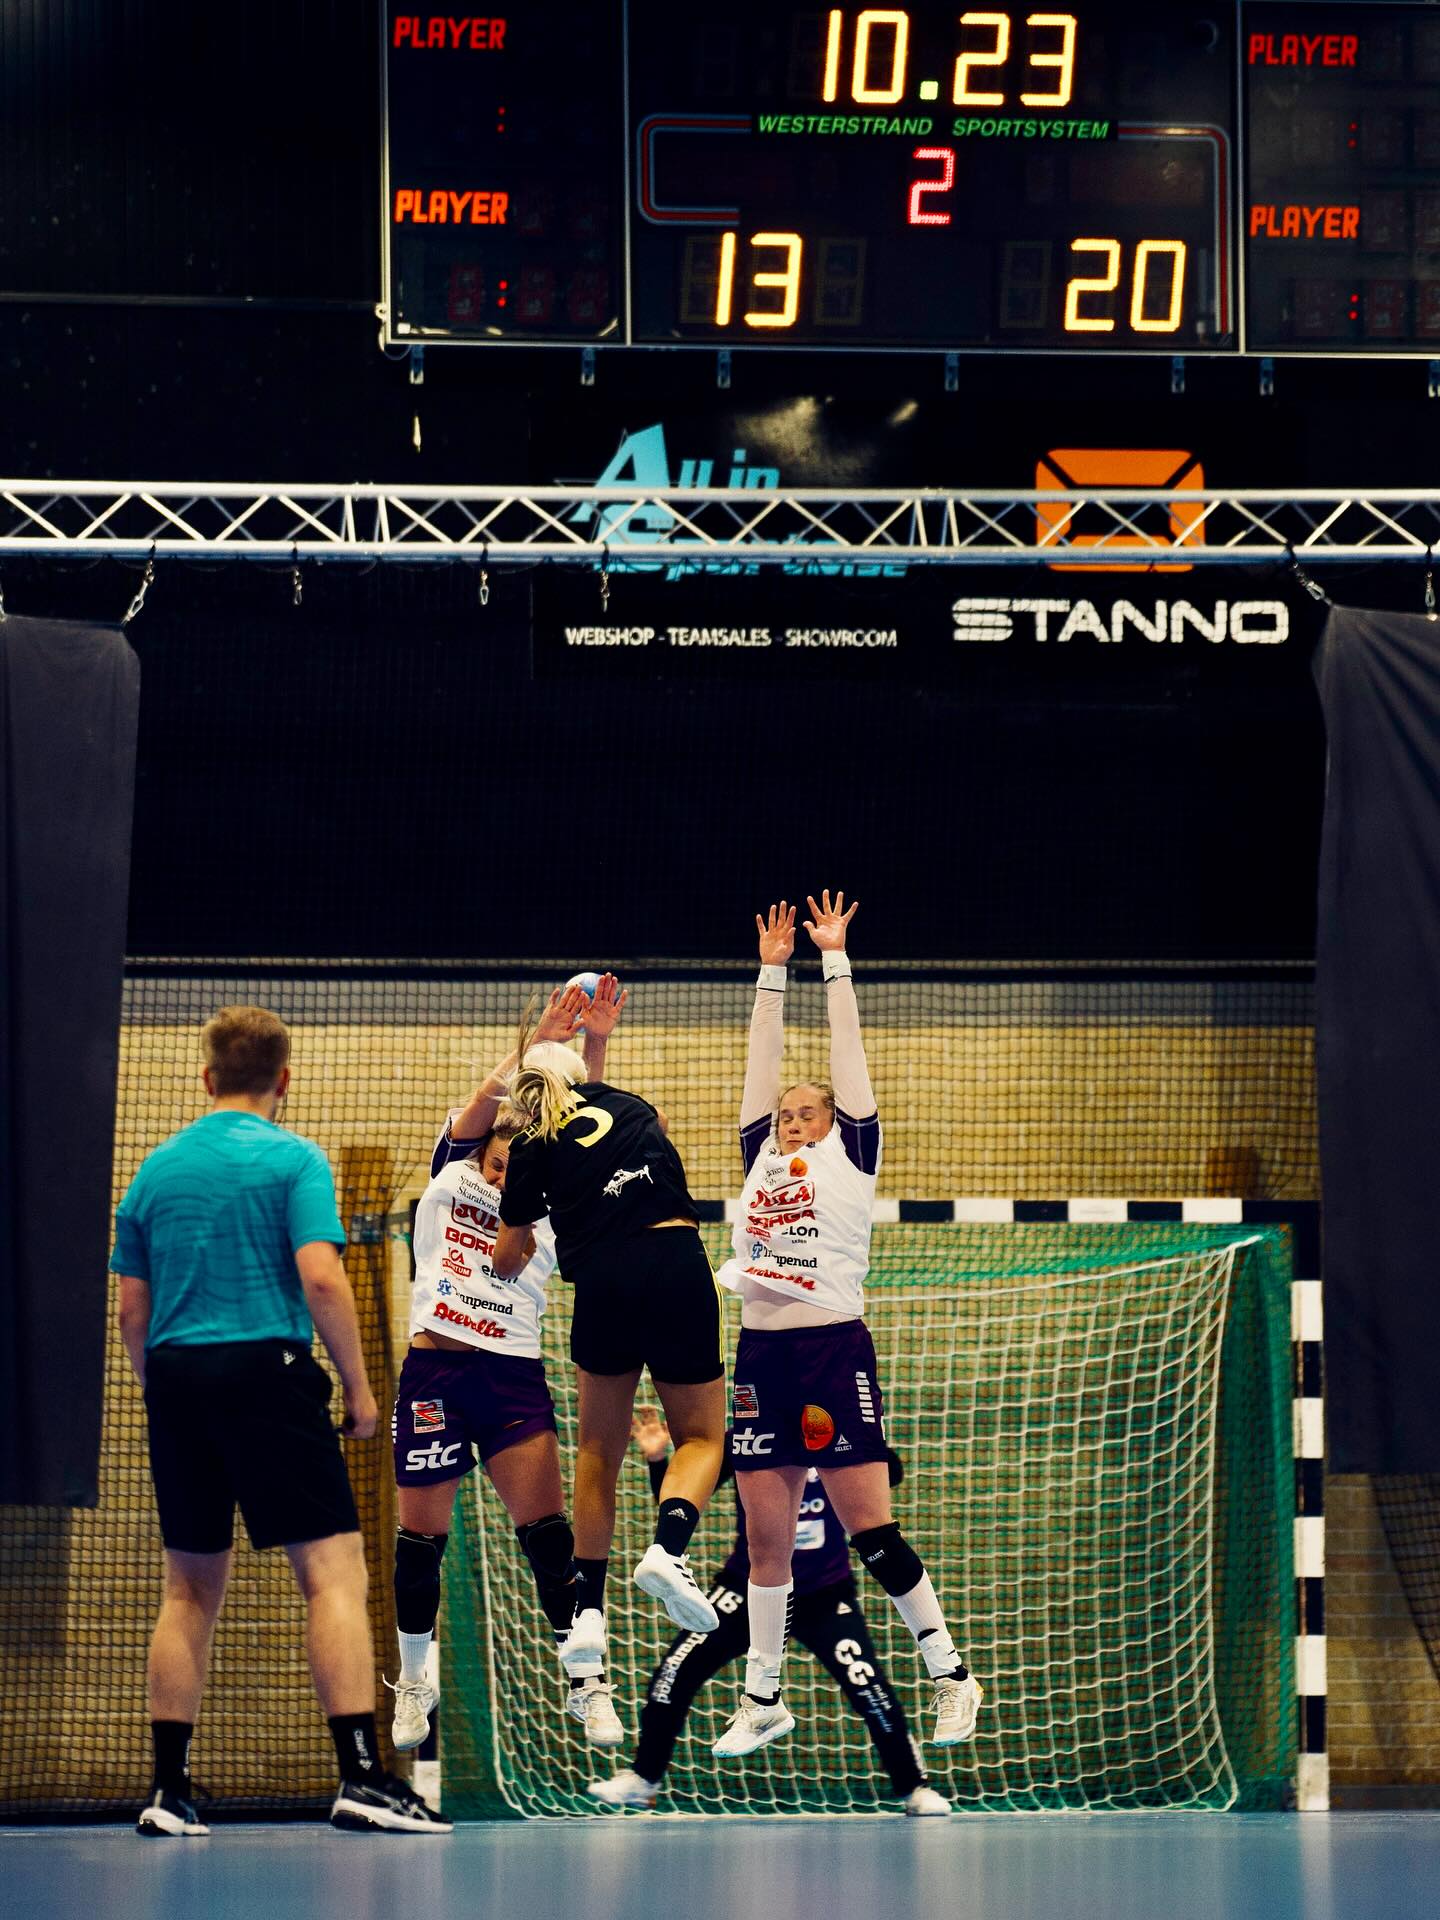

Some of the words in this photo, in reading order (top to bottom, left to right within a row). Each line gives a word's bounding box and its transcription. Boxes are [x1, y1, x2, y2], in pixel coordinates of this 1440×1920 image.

[394, 16, 507, 49] PLAYER
[820, 9, 1078, 106] 10.23
[1248, 33, 1359, 67] PLAYER
[758, 115, 933, 135] WESTERSTRAND
[952, 118, 1110, 139] SPORTSYSTEM
[908, 147, 956, 225] 2
[394, 189, 508, 225] PLAYER
[1250, 204, 1360, 239] PLAYER
[714, 231, 803, 328] 13
[1063, 238, 1187, 332] 20
[565, 626, 655, 646] WEBSHOP
[666, 627, 772, 648] TEAMSALES
[784, 628, 898, 648] SHOWROOM
[952, 598, 1290, 645] STANNO
[455, 1203, 498, 1233] JUL
[405, 1440, 462, 1471] stc
[732, 1427, 776, 1456] stc
[834, 1444, 853, 1453] SELECT
[866, 1549, 885, 1563] SELECT
